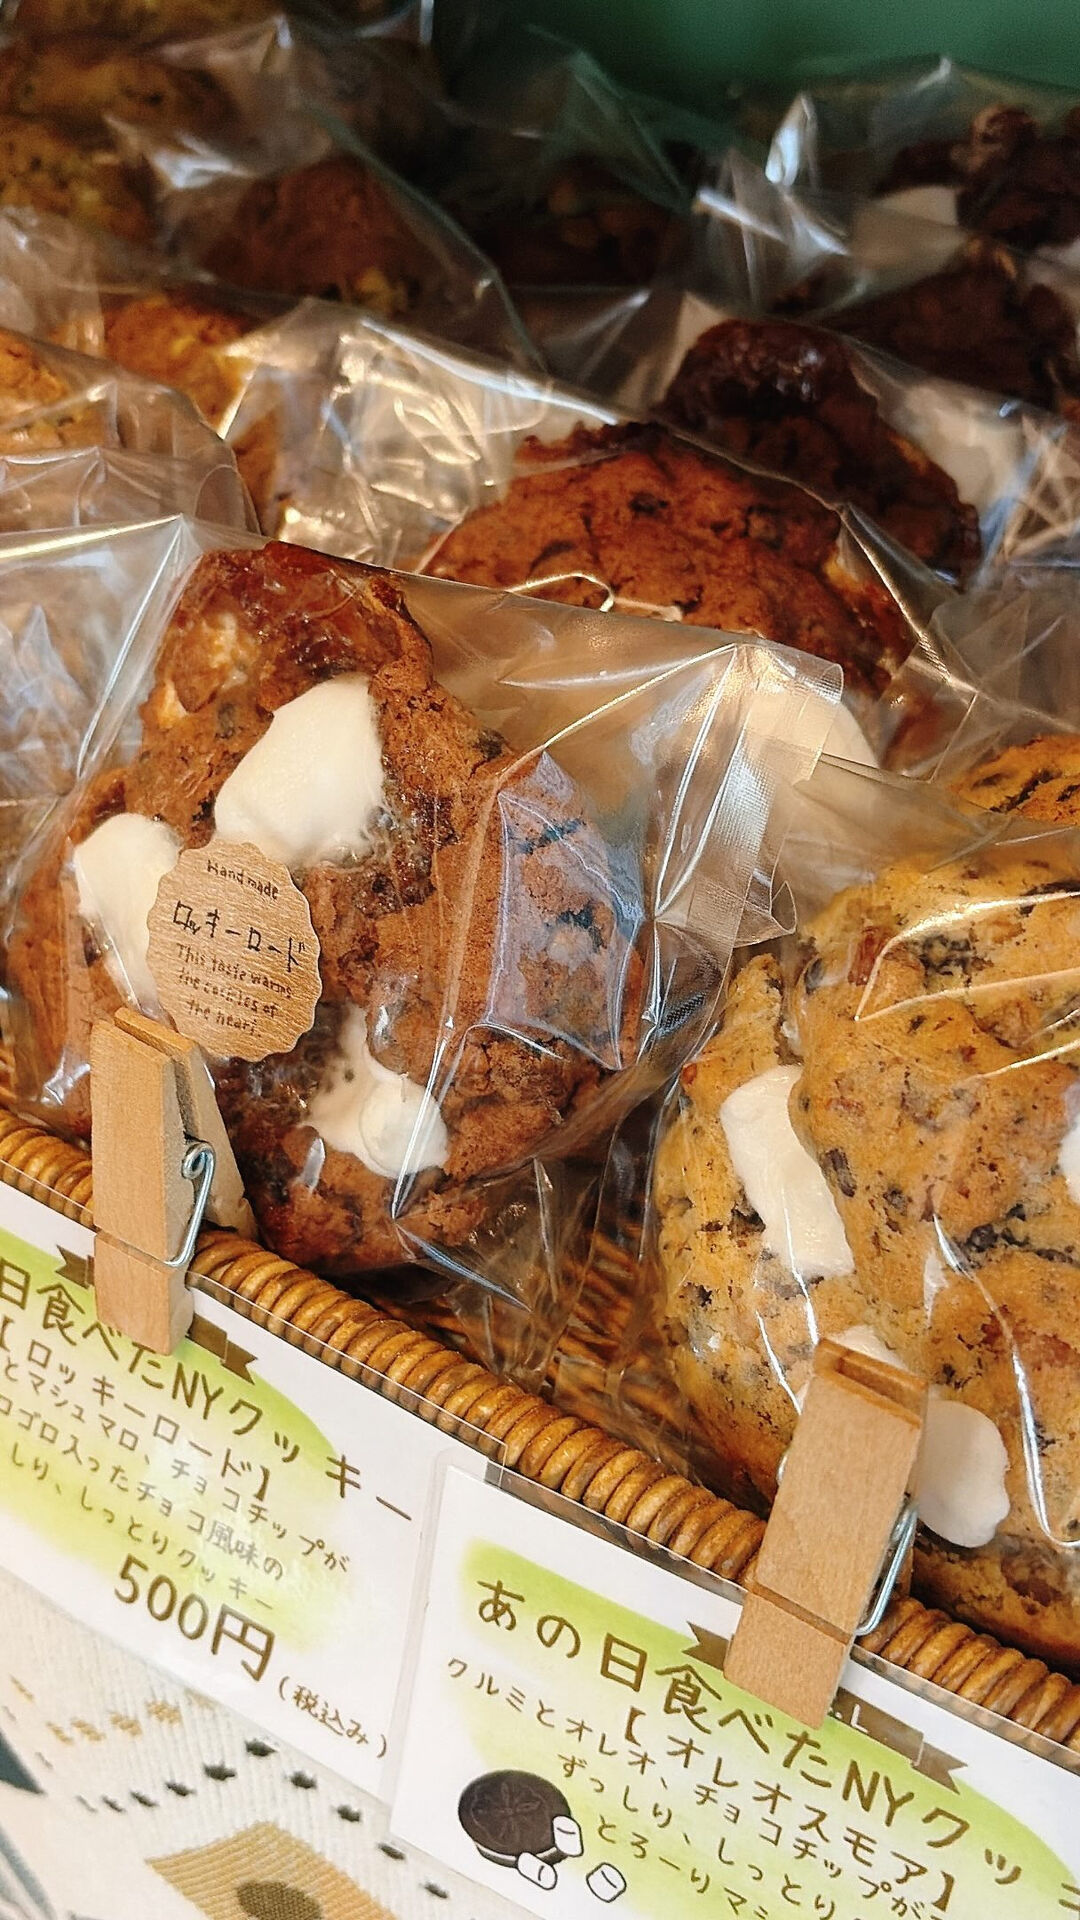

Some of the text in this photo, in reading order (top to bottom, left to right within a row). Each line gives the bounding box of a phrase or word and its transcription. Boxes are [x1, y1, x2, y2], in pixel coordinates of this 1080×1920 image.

[172, 900, 306, 973] ロッキーロード
[177, 943, 293, 999] This taste warms
[179, 967, 200, 990] the
[262, 1001, 279, 1019] of
[186, 996, 211, 1021] the
[3, 1356, 351, 1573] とマシュマロ、チョコチップが
[113, 1553, 276, 1683] 500円
[448, 1657, 944, 1920] クルミとオレオ、チョコチップが
[557, 1753, 862, 1920] ずっしり、しっとり
[624, 1706, 955, 1913] 【オレオスモア】
